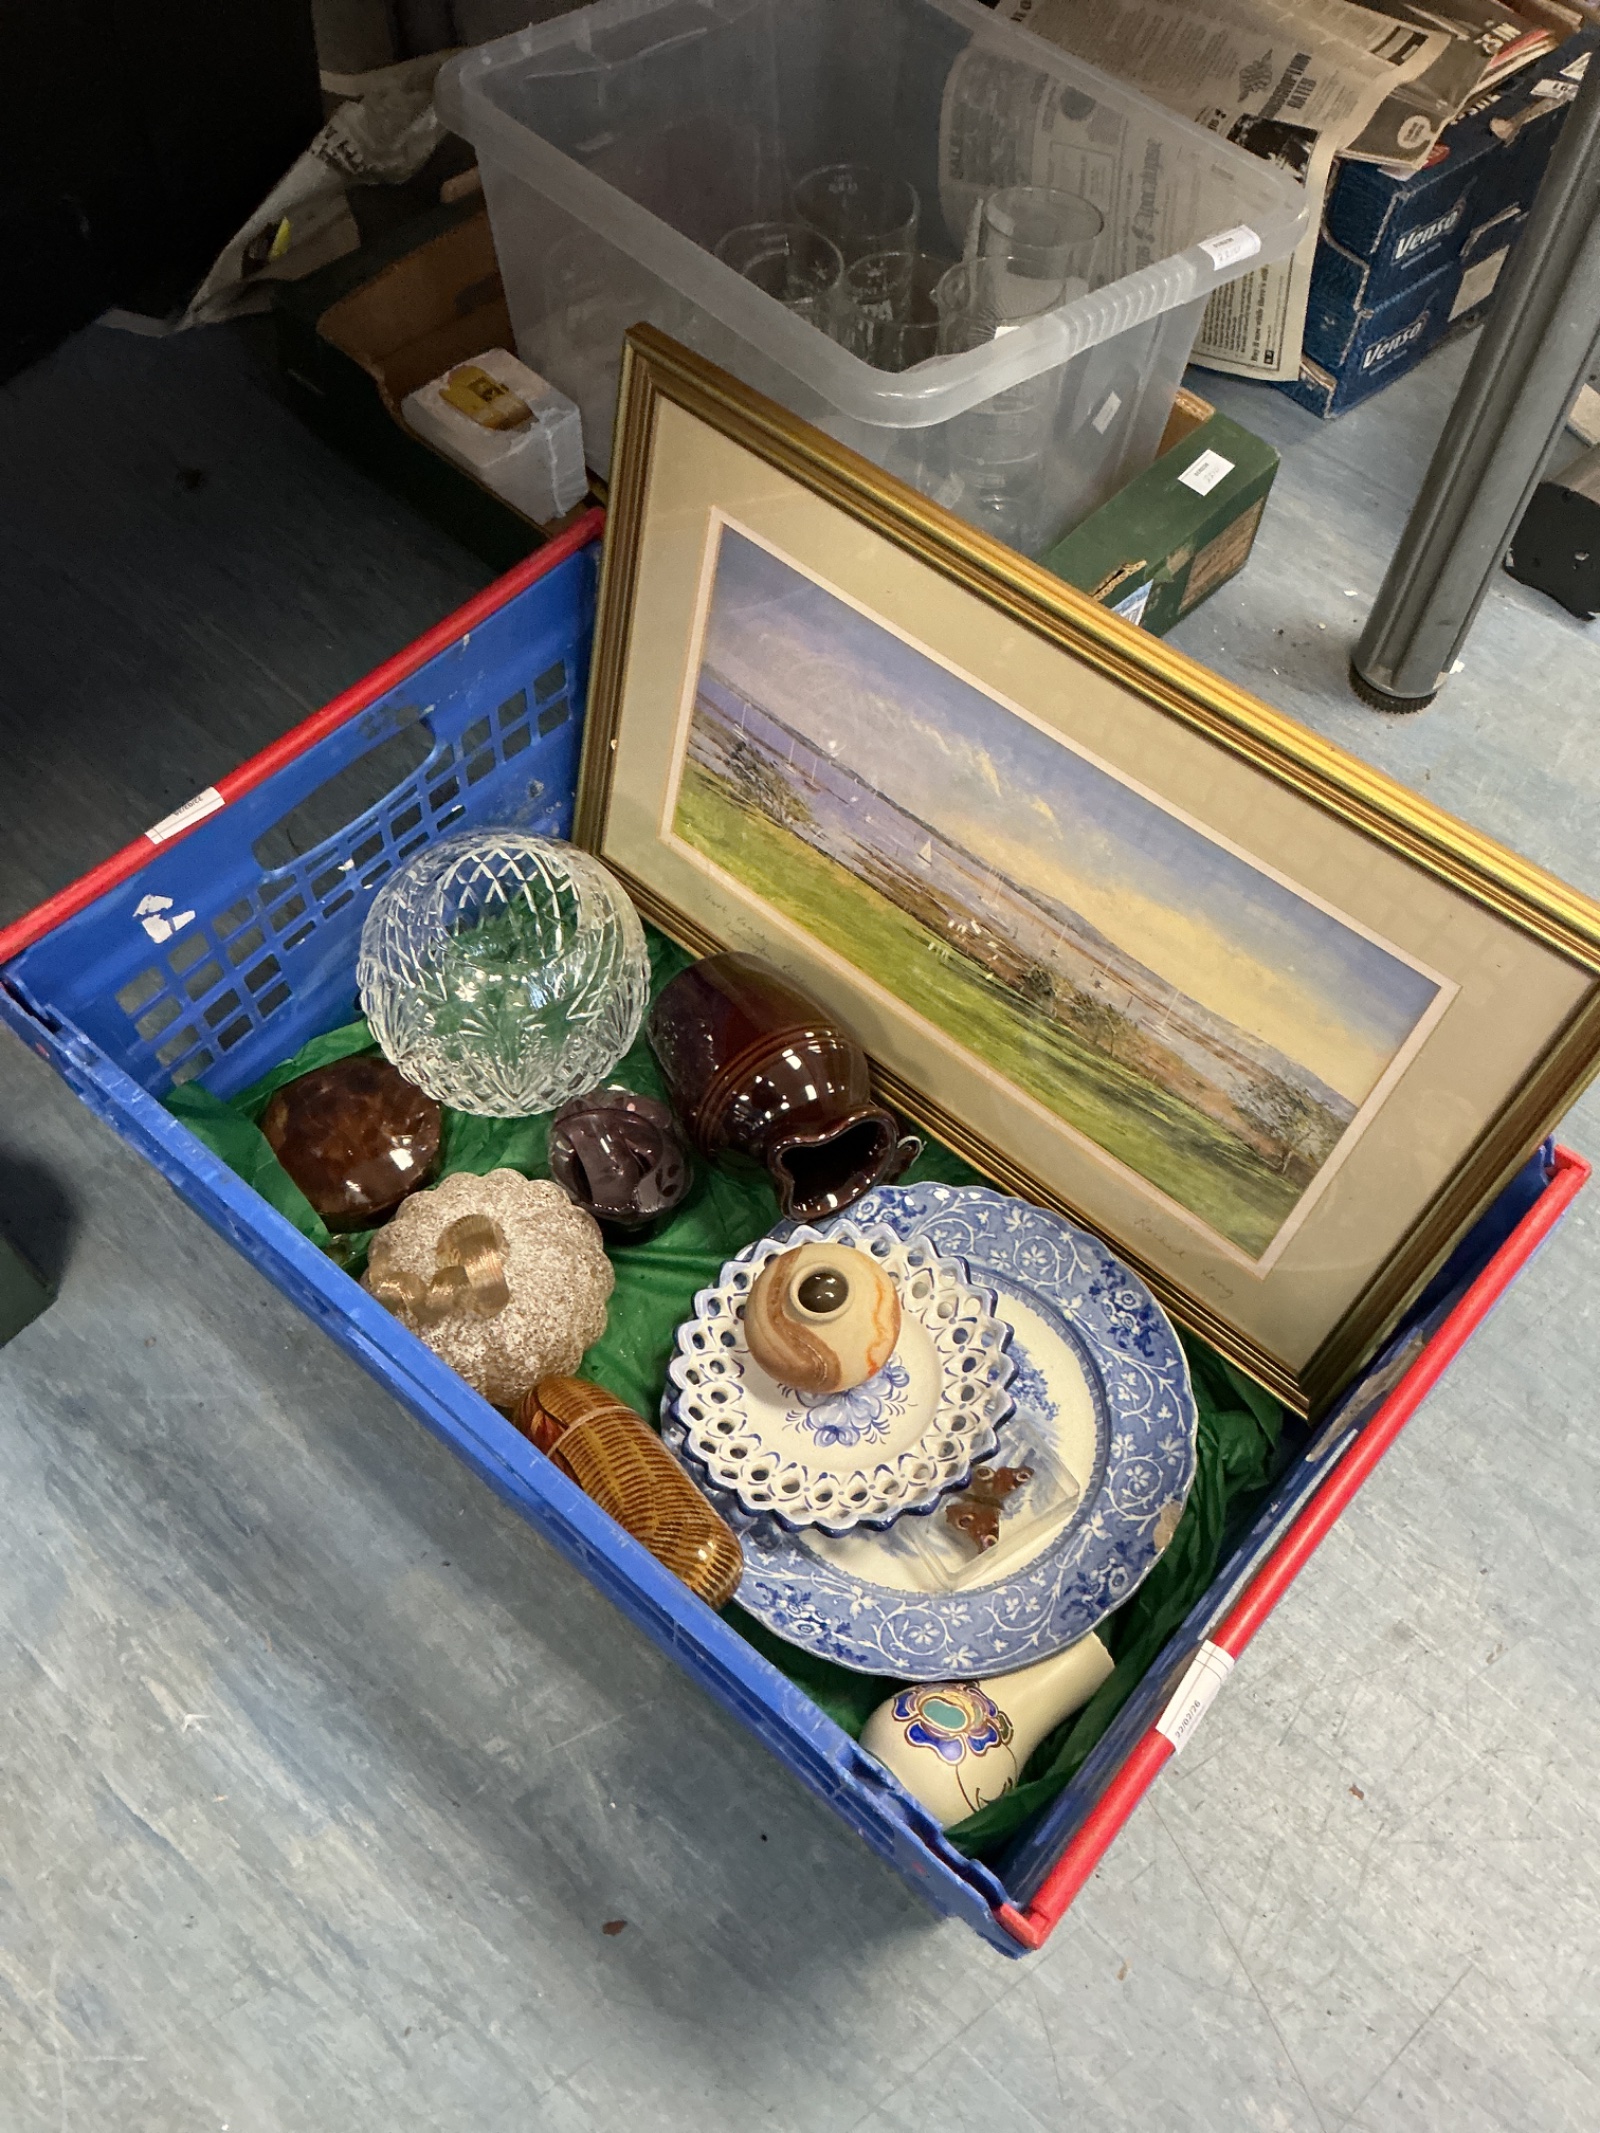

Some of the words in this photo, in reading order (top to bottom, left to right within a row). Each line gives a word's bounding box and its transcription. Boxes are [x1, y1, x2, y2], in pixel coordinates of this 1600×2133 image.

[1395, 210, 1459, 260] Venso
[1362, 321, 1423, 369] Venso
[1175, 1699, 1201, 1738] 22/02/26
